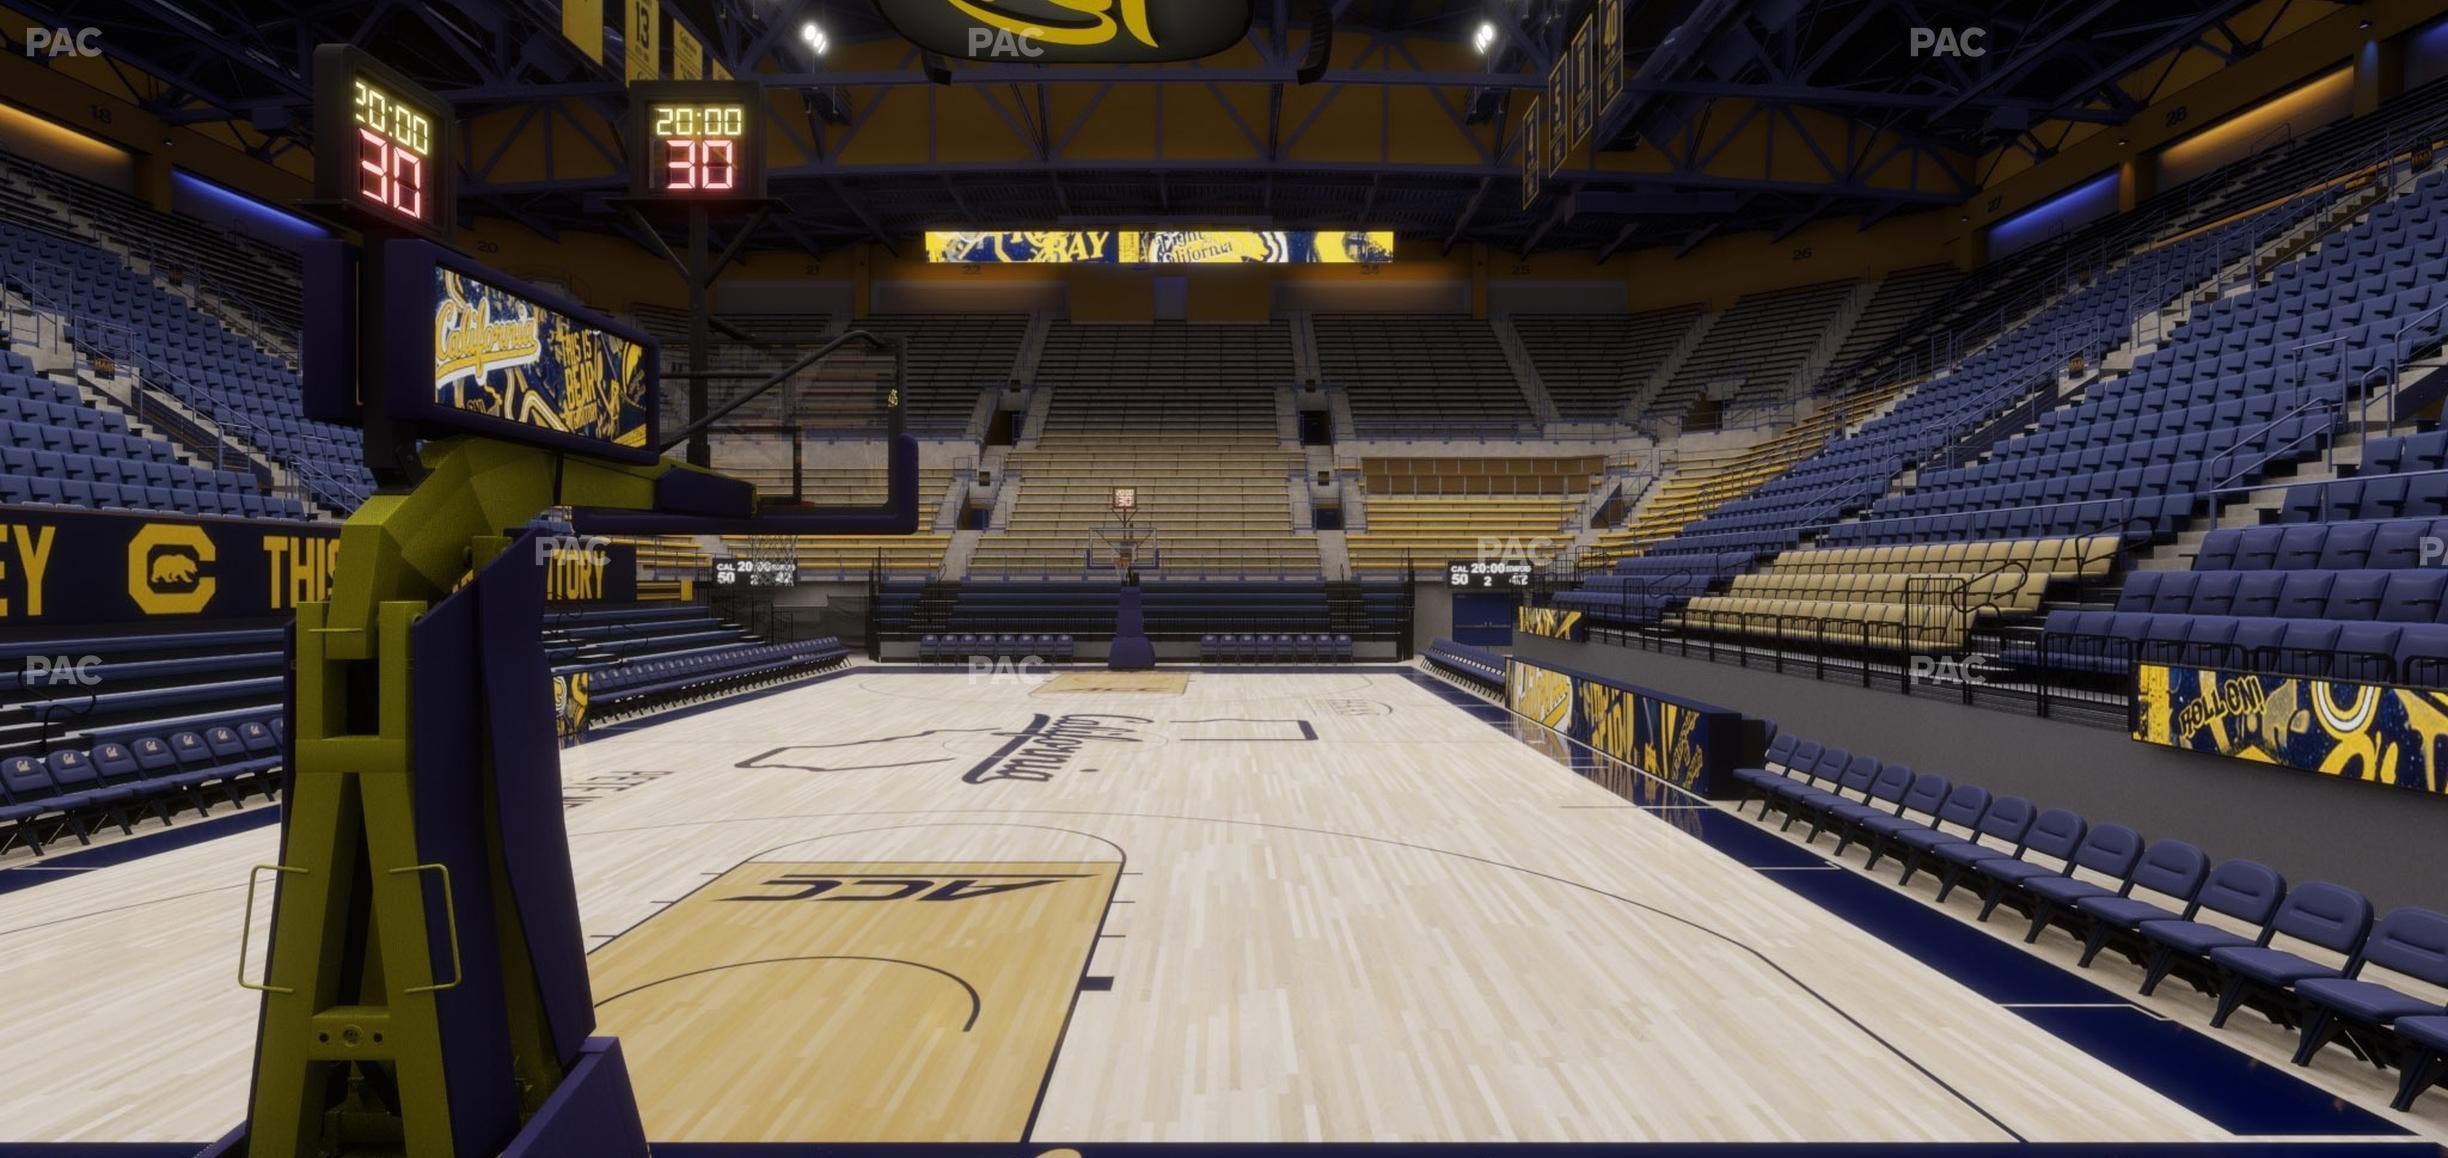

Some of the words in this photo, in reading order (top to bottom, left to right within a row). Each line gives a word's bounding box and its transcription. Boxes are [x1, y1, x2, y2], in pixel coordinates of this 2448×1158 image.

[636, 1, 650, 49] 13
[355, 81, 428, 155] 20:00
[655, 108, 742, 136] 20:00
[359, 127, 421, 219] 30
[666, 139, 733, 190] 30
[477, 239, 498, 253] 20
[960, 264, 982, 275] 22
[435, 298, 540, 384] California
[564, 360, 598, 412] BEAR
[716, 563, 736, 571] CAL
[717, 572, 735, 584] 50
[1450, 565, 1469, 573] CAL
[1470, 563, 1505, 574] 20:00
[1451, 574, 1469, 585] 50
[1483, 575, 1493, 587] 2
[2179, 687, 2227, 738] ROLL
[2223, 675, 2266, 715] ON!
[961, 713, 1154, 784] California
